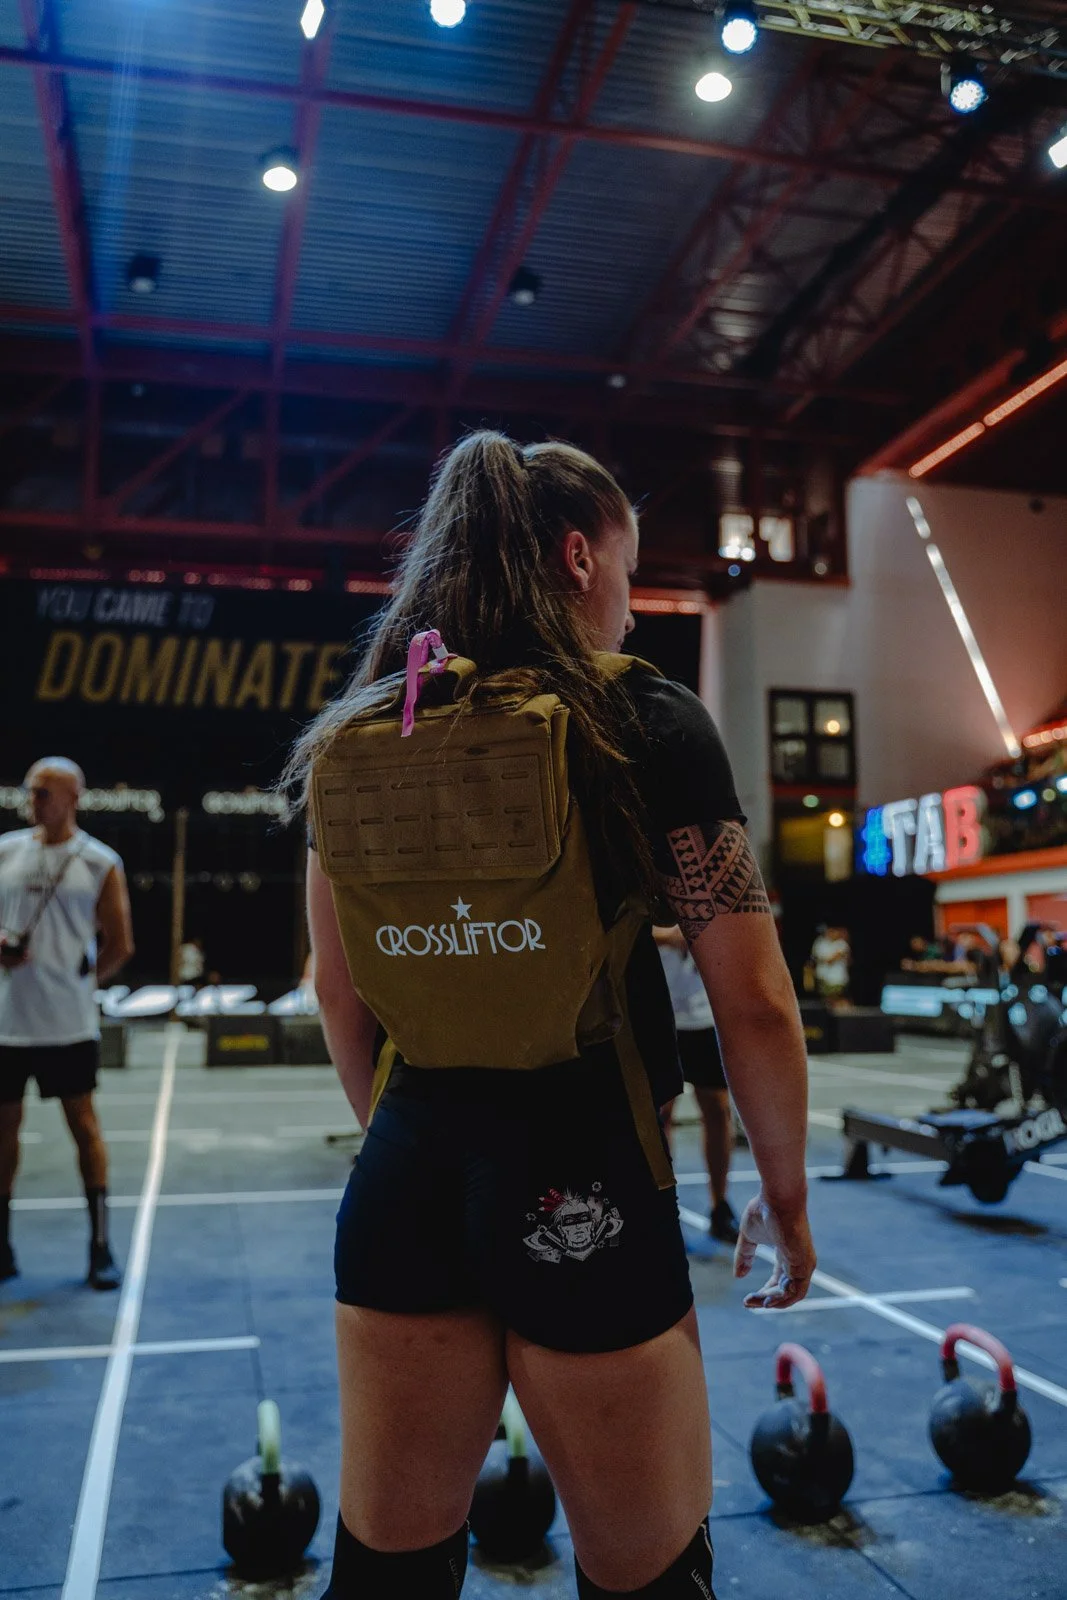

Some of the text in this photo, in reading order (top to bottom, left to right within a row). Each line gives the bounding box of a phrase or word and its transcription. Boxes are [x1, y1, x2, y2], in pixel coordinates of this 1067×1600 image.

[36, 586, 216, 629] YOU CAME TO
[35, 630, 347, 711] DOMINATE
[376, 918, 546, 956] CROSSLIFTOR
